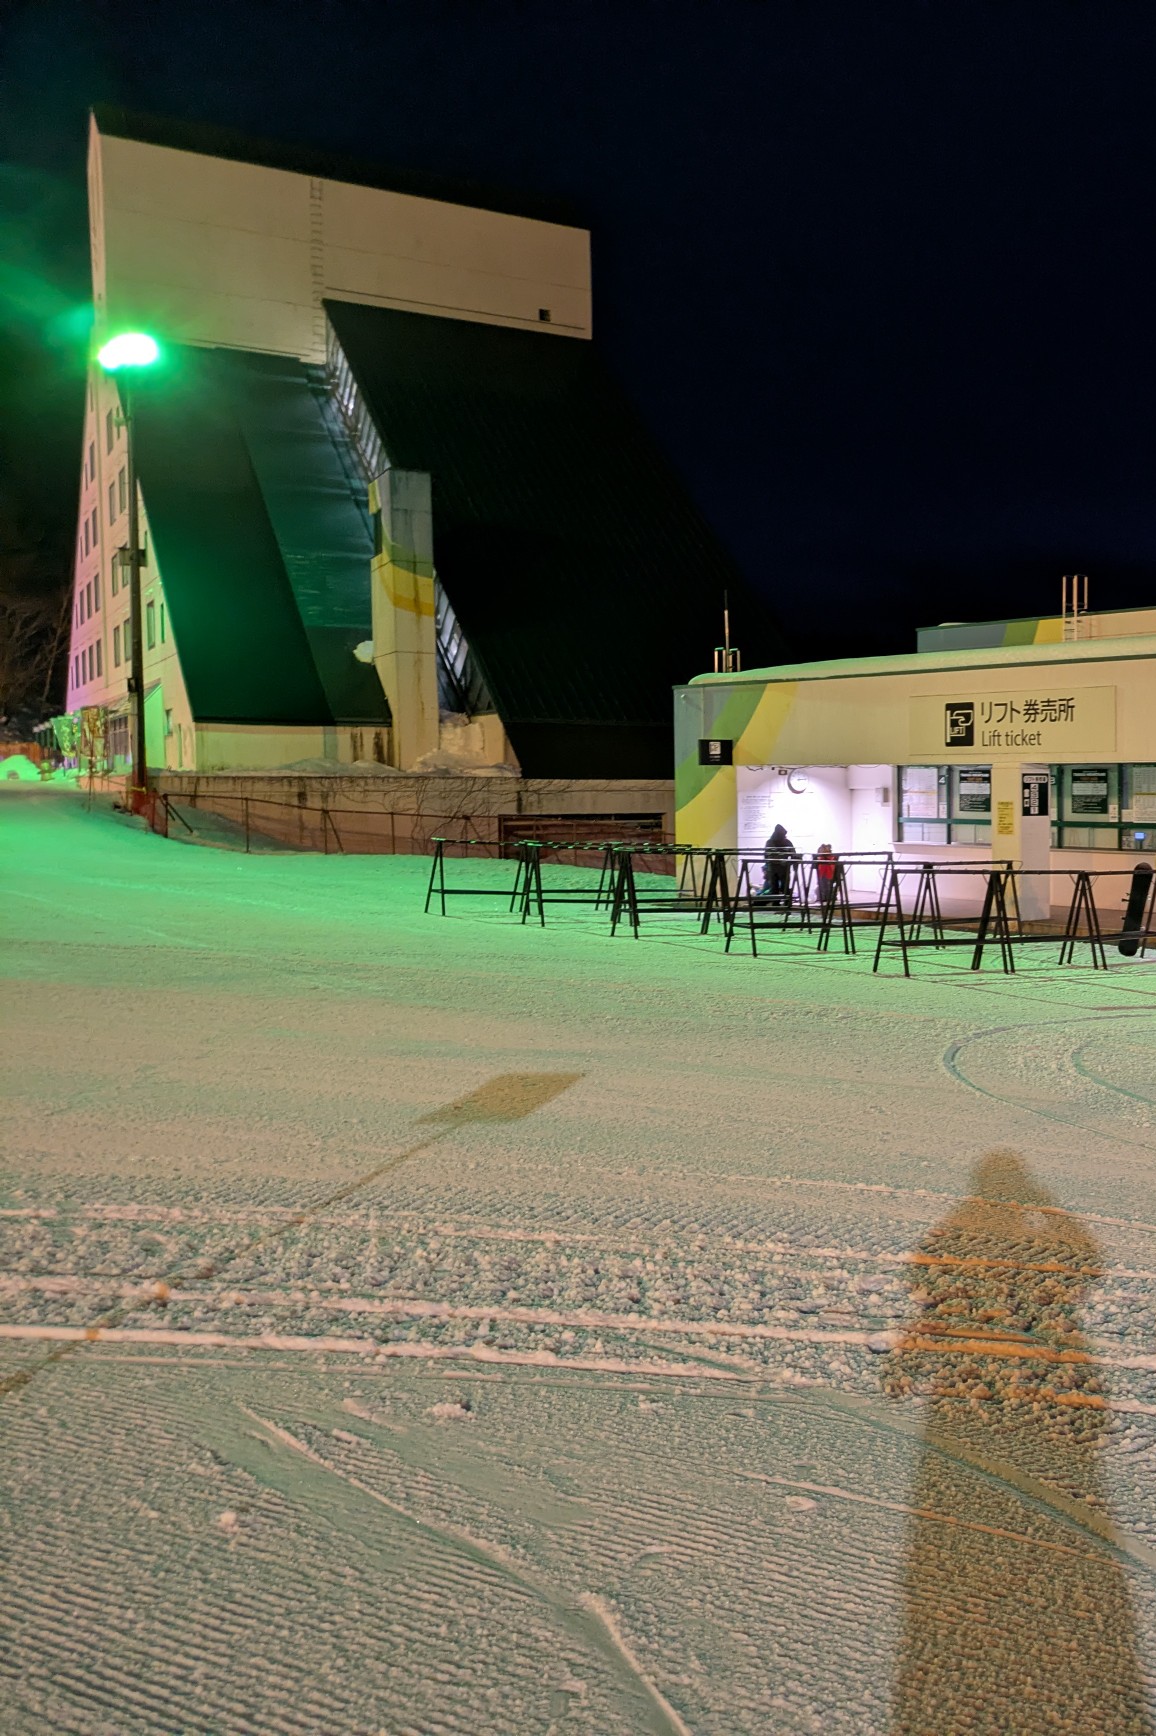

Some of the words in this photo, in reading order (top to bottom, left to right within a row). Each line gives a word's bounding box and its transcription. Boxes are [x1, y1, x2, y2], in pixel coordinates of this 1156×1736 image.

[981, 697, 1076, 723] リフト券売所
[981, 730, 1002, 747] Lift
[1005, 729, 1042, 747] ticket
